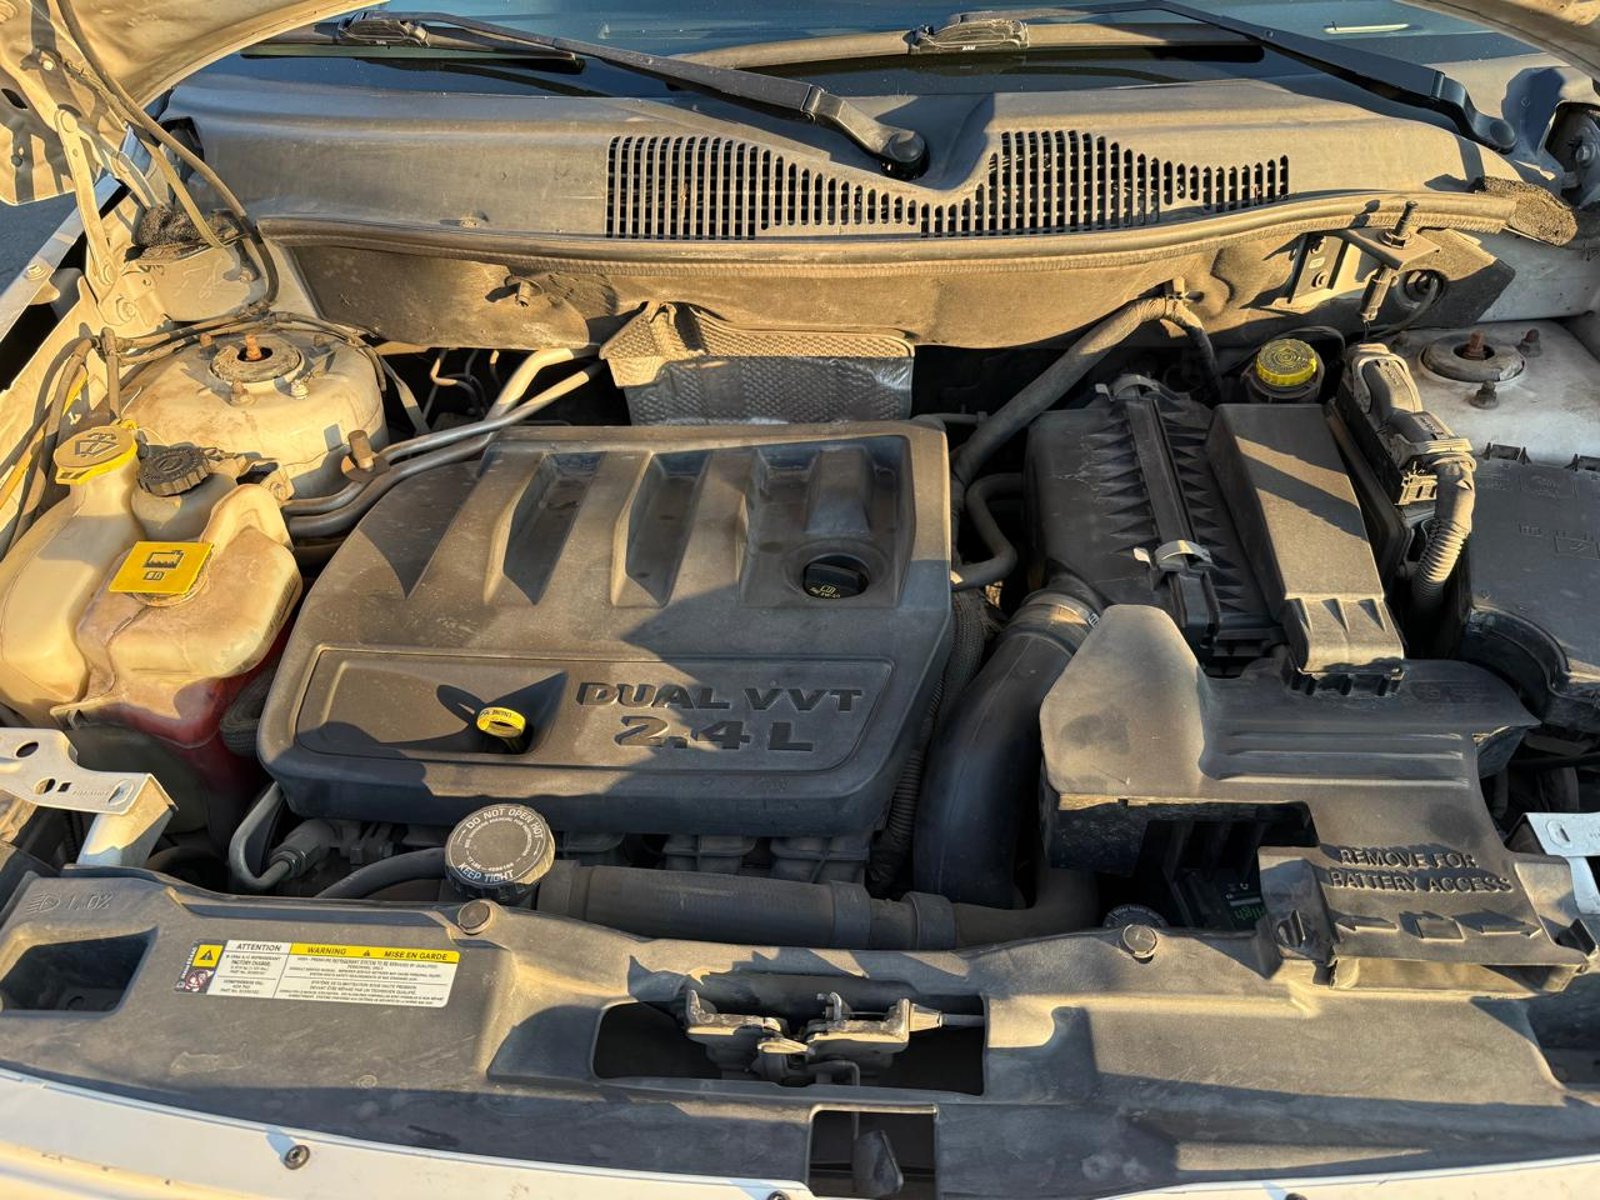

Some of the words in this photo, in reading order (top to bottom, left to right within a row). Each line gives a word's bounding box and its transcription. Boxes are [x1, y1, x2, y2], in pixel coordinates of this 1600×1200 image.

[575, 681, 732, 709] DUAL
[743, 687, 863, 712] VVT
[614, 714, 750, 751] 2.4
[767, 721, 814, 752] L
[466, 817, 481, 829] DO
[483, 808, 505, 820] NOT
[508, 808, 534, 823] OPEN
[530, 822, 543, 839] HOT
[1339, 849, 1428, 868] REMOVE
[1431, 851, 1479, 869] FOR
[458, 862, 482, 880] KEEP
[484, 869, 514, 883] TIGHT
[1329, 871, 1418, 892] BATTERY
[1428, 875, 1514, 893] ACCESS
[236, 943, 281, 952] ATTENTION
[307, 946, 347, 955] WARNING
[419, 952, 448, 960] GARDE
